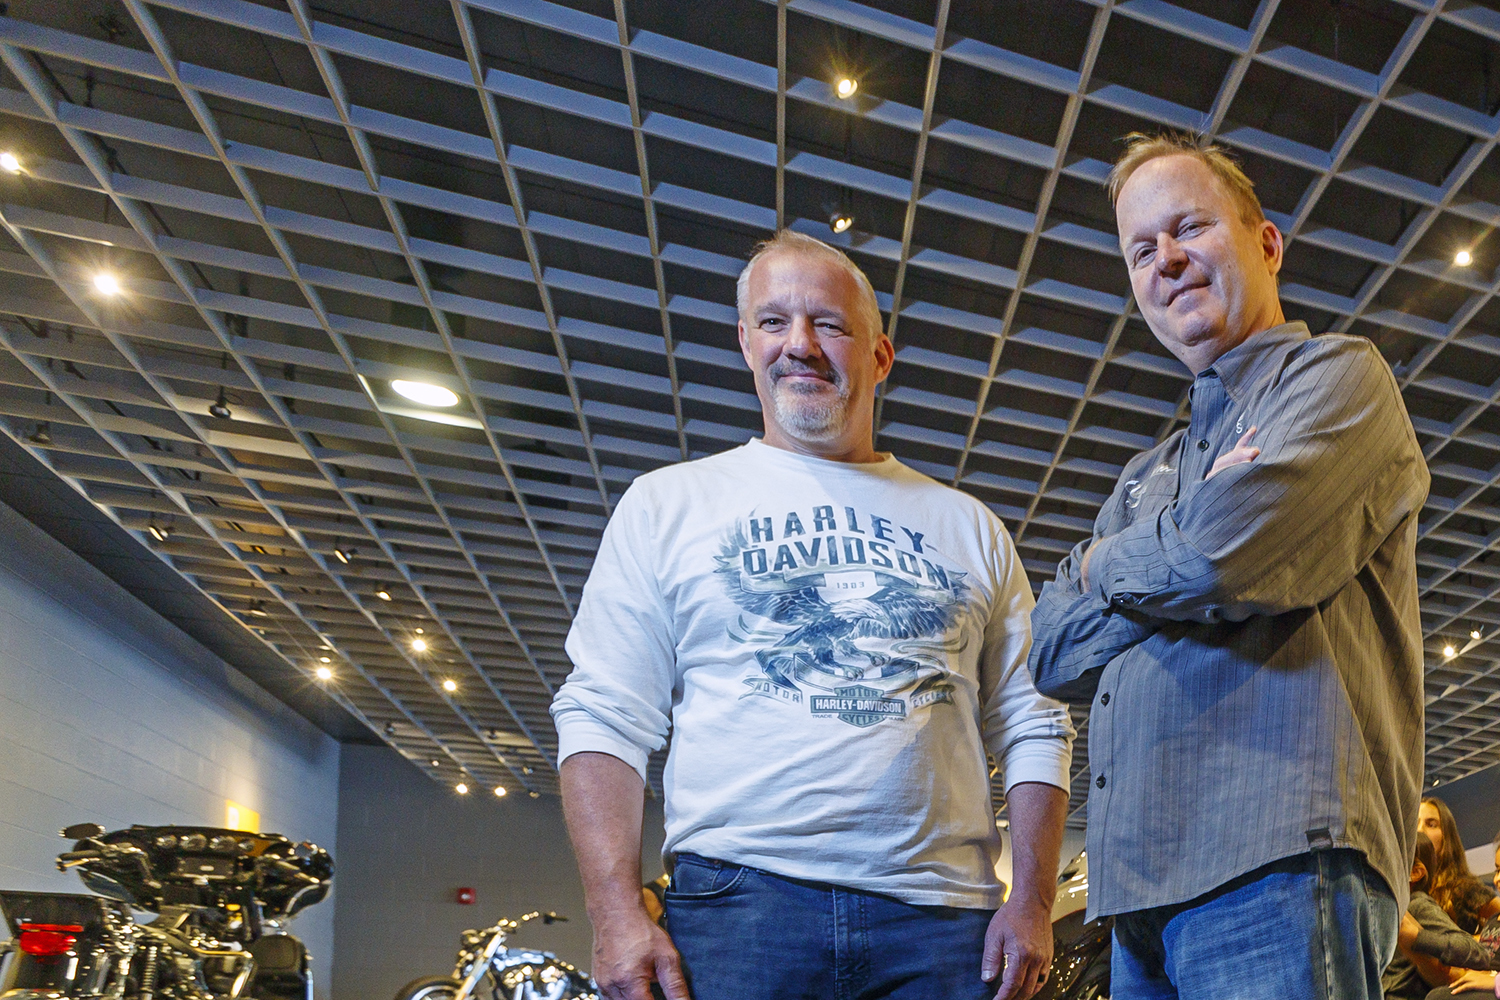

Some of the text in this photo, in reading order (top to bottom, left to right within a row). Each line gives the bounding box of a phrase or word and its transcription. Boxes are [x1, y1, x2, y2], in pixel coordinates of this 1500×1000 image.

[750, 505, 938, 555] HARLEY-
[742, 535, 950, 590] DAVIDSON
[836, 581, 865, 590] 1903
[840, 687, 878, 698] MOTOR
[815, 698, 902, 713] HARLEY-DAVIDSON
[842, 713, 880, 726] CYCLES
